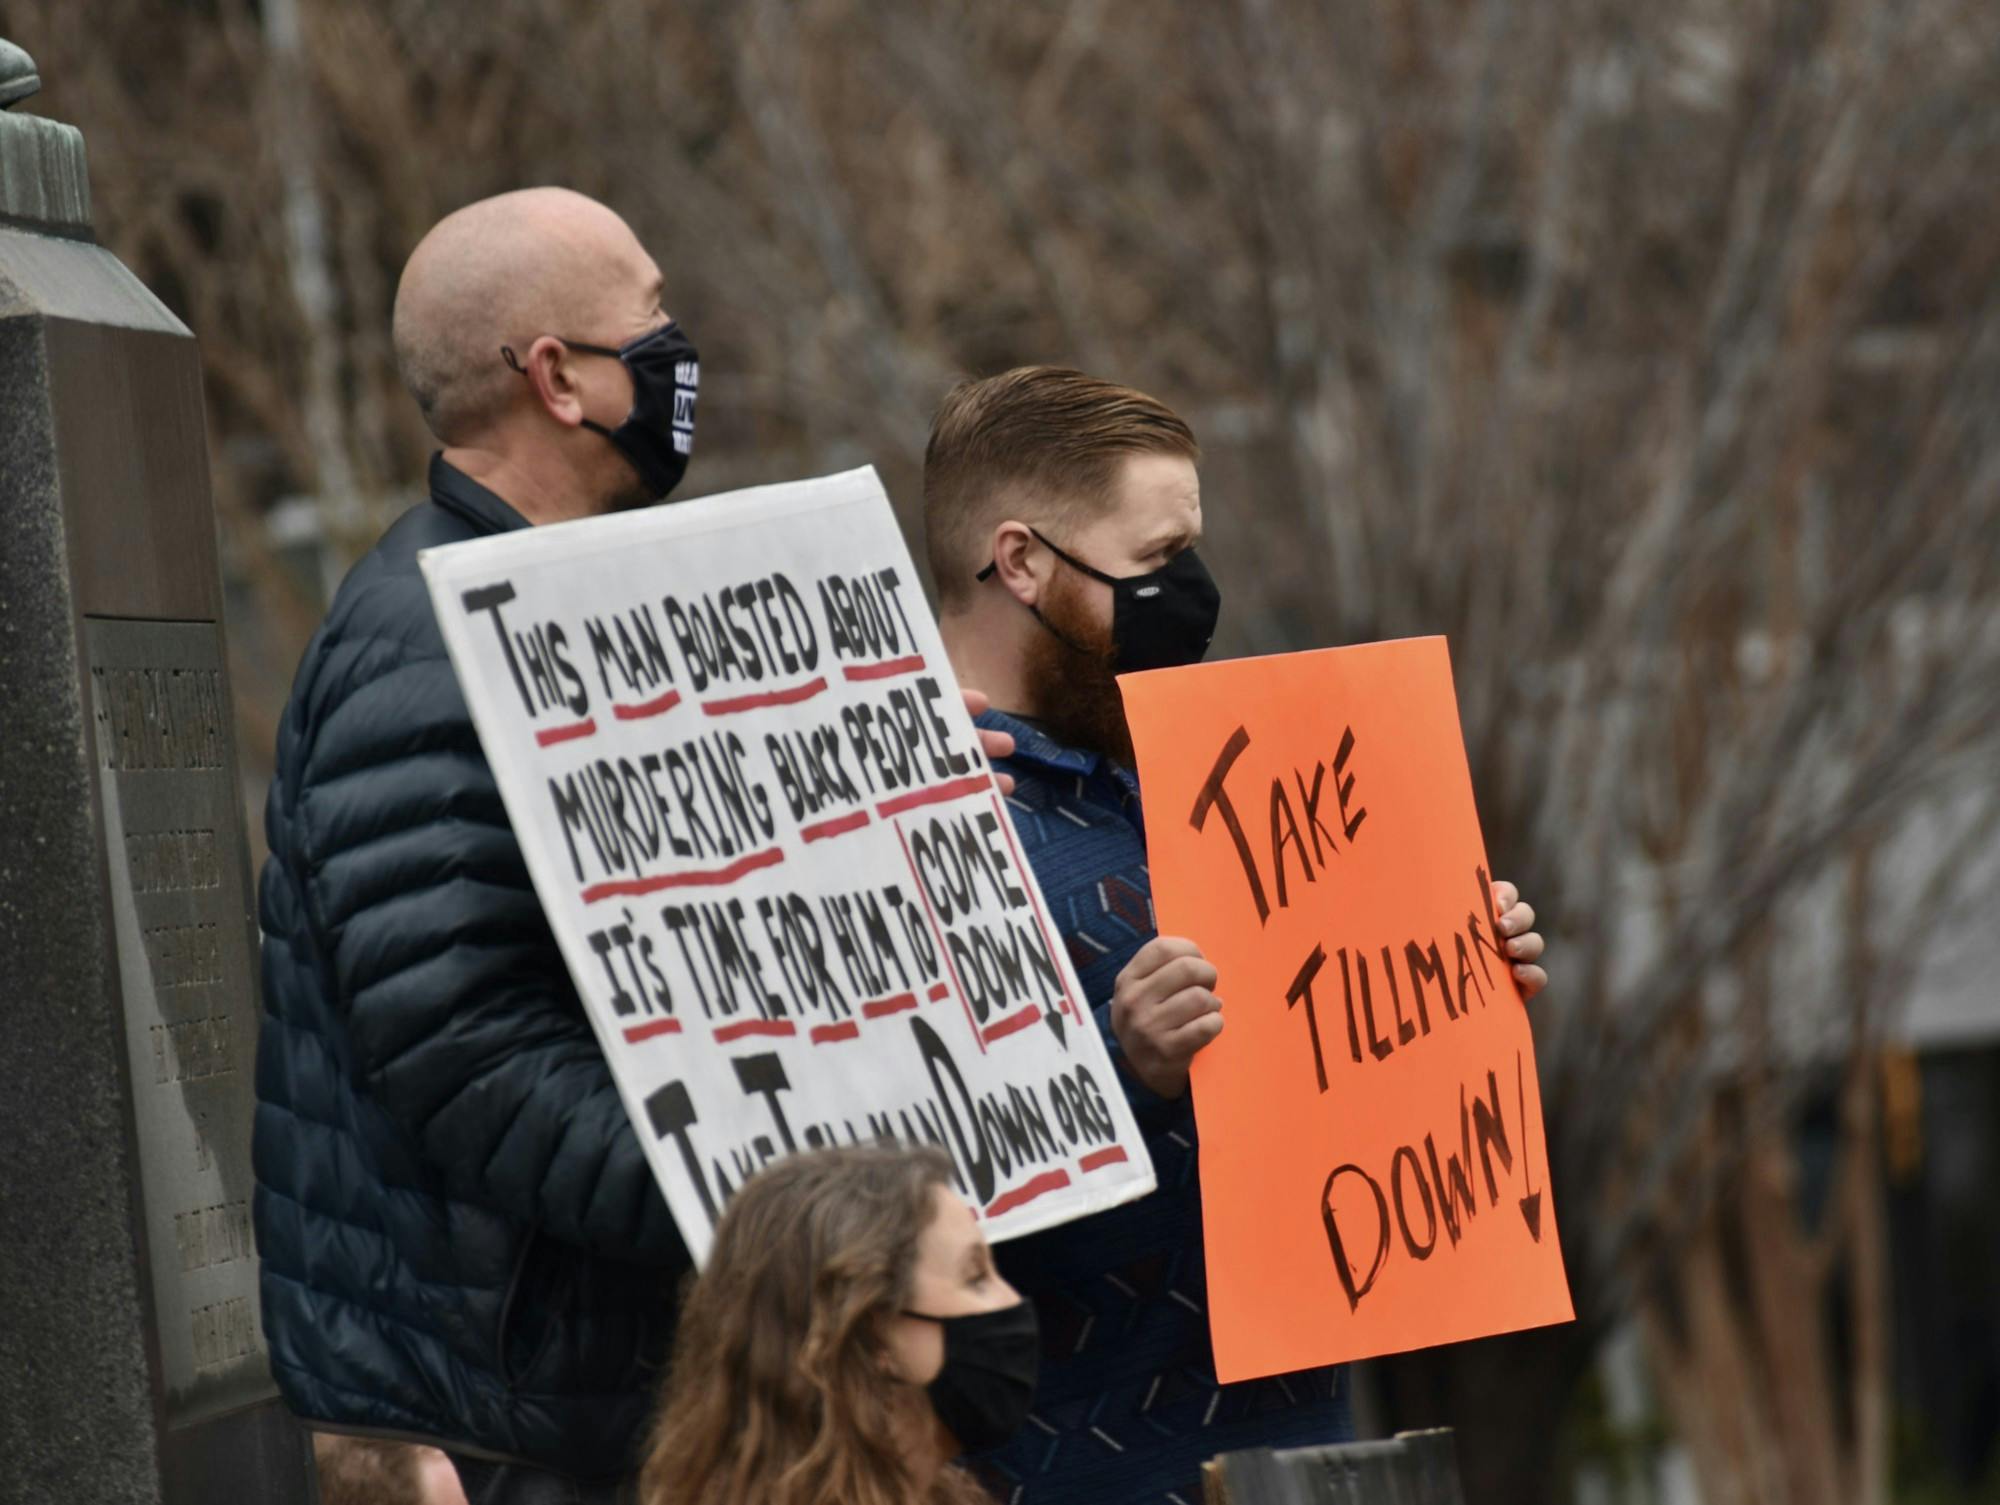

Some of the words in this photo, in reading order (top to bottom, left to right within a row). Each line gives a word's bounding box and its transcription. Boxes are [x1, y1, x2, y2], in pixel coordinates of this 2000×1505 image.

[461, 581, 588, 717] THIS
[584, 611, 675, 698] MAN
[661, 572, 820, 693] BOASTED
[817, 567, 921, 661] ABOUT
[547, 731, 776, 882] MURDERING
[764, 723, 862, 823] BLACK
[841, 677, 982, 795] PEOPLE.
[1189, 725, 1368, 929] TAKE
[911, 811, 1028, 926] COME
[661, 897, 788, 1021] TIME
[756, 892, 852, 1021] FOR
[819, 889, 911, 997] HIM
